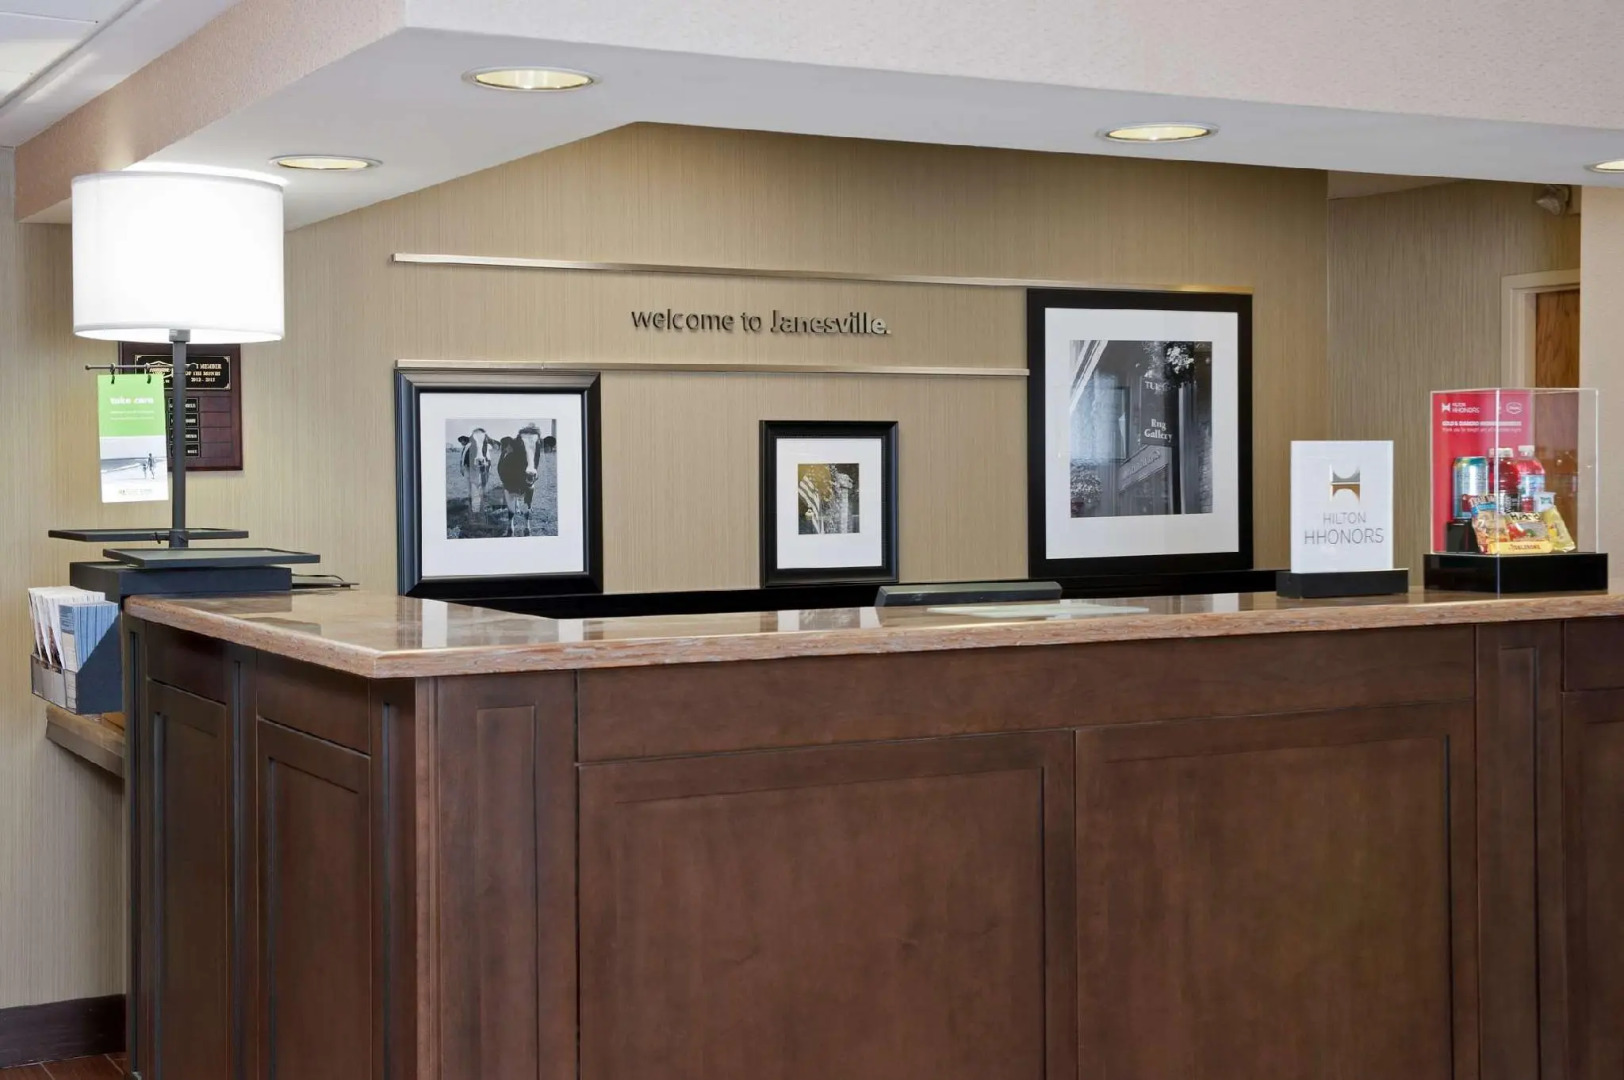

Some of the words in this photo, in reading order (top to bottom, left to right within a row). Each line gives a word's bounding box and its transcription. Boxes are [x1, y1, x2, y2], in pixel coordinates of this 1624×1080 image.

[631, 308, 735, 331] welcome
[741, 311, 762, 332] to
[770, 310, 892, 335] Janesville.
[1144, 428, 1172, 442] Gallery
[1323, 511, 1366, 525] HILTON
[1304, 527, 1384, 545] HHONORS
